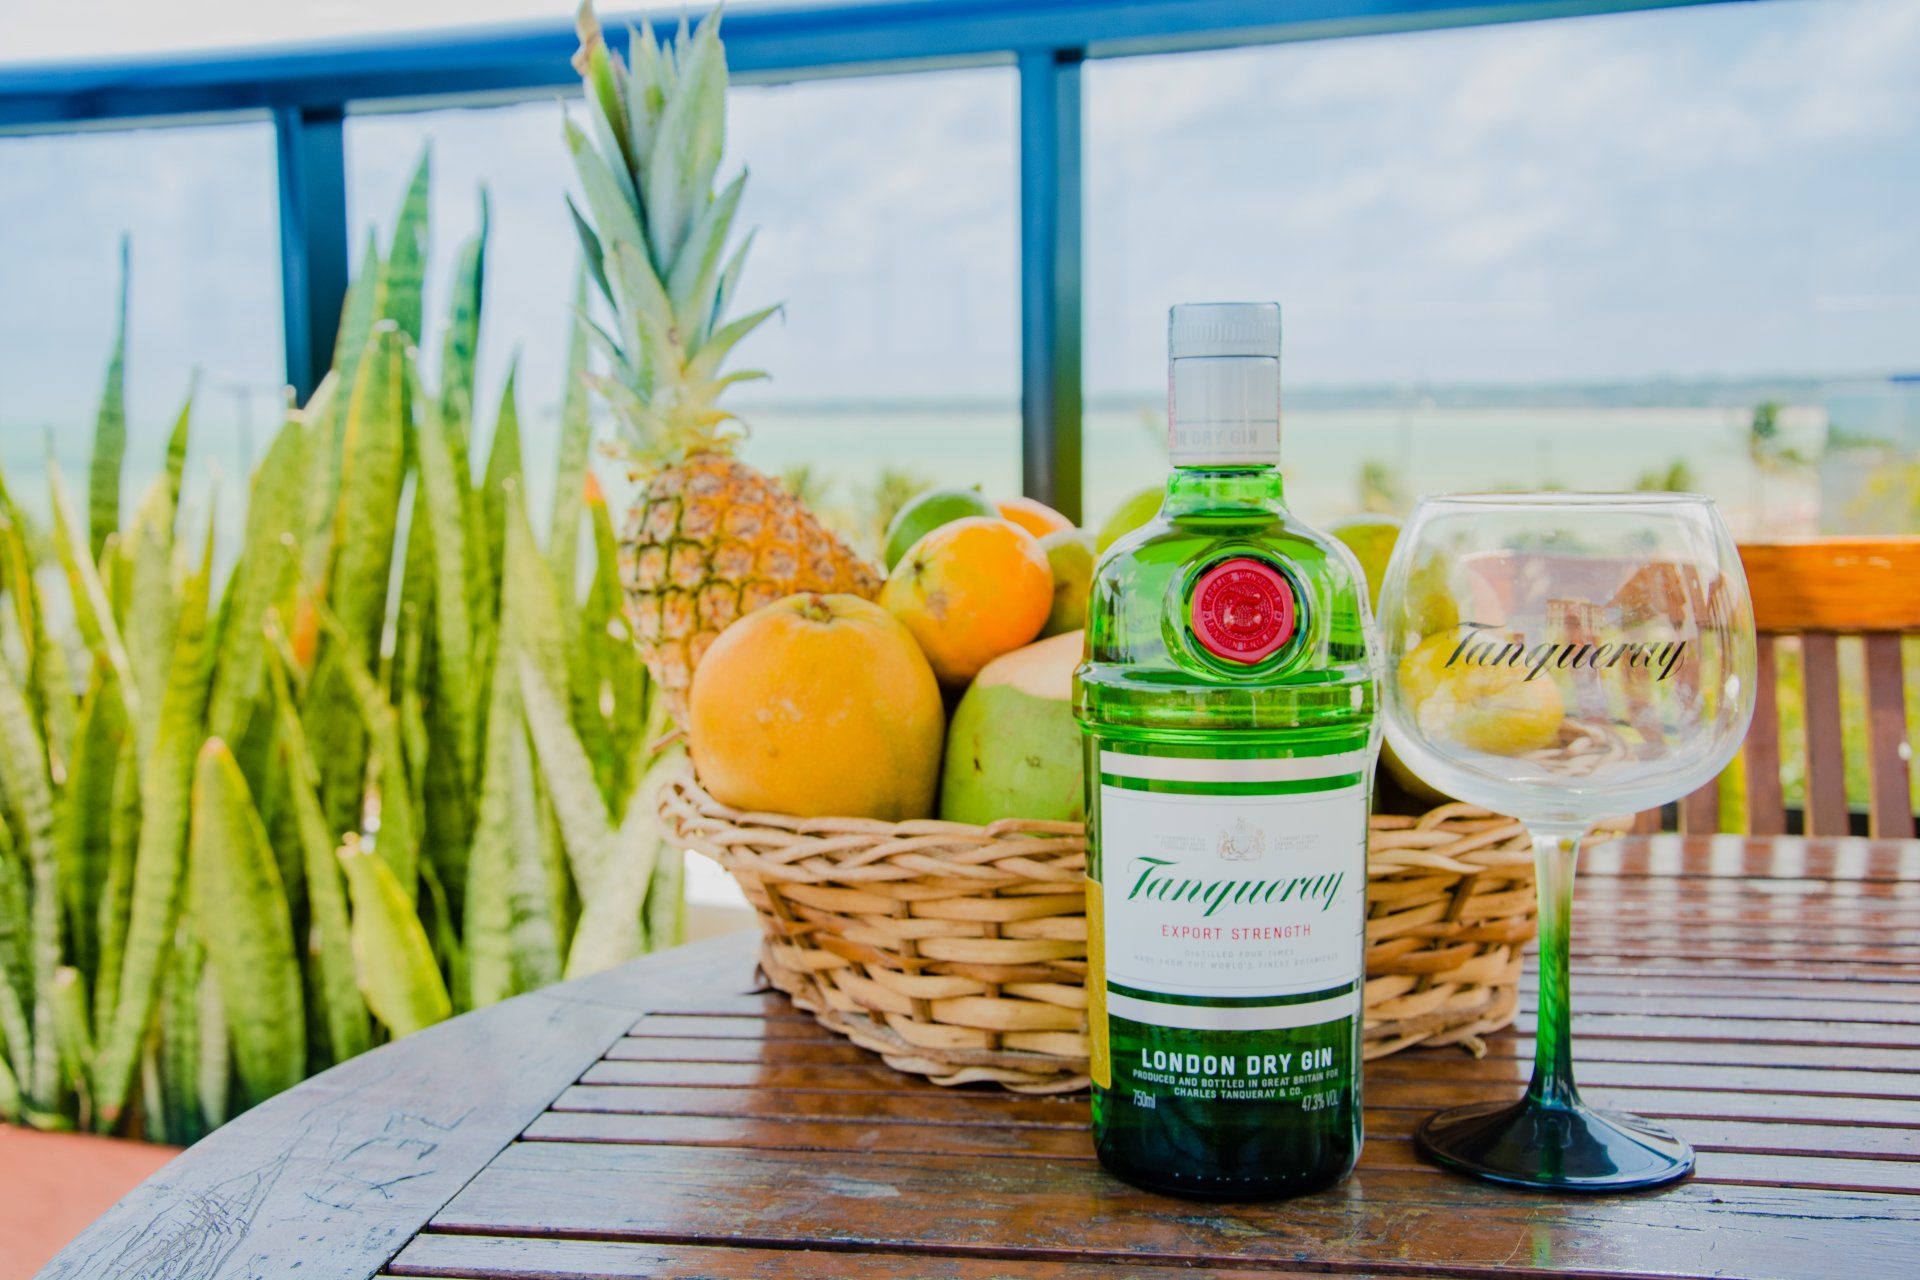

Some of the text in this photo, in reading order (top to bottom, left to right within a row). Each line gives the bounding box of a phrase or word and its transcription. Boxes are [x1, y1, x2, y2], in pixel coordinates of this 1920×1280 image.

[1192, 430, 1224, 445] DRY
[1230, 430, 1258, 445] GIN
[1444, 621, 1687, 682] Tanqueray
[1127, 856, 1344, 917] Tanqueray
[1161, 923, 1311, 940] EXPORT STRENGTH
[1141, 1046, 1332, 1076] LONDON DRY GIN
[1132, 1068, 1339, 1089] PRODUCED AND BOTTLED IN GREAT BRITAIN FOR
[1132, 1088, 1156, 1109] 750ml
[1174, 1086, 1303, 1100] CHARLES TANQUERAY & CO.
